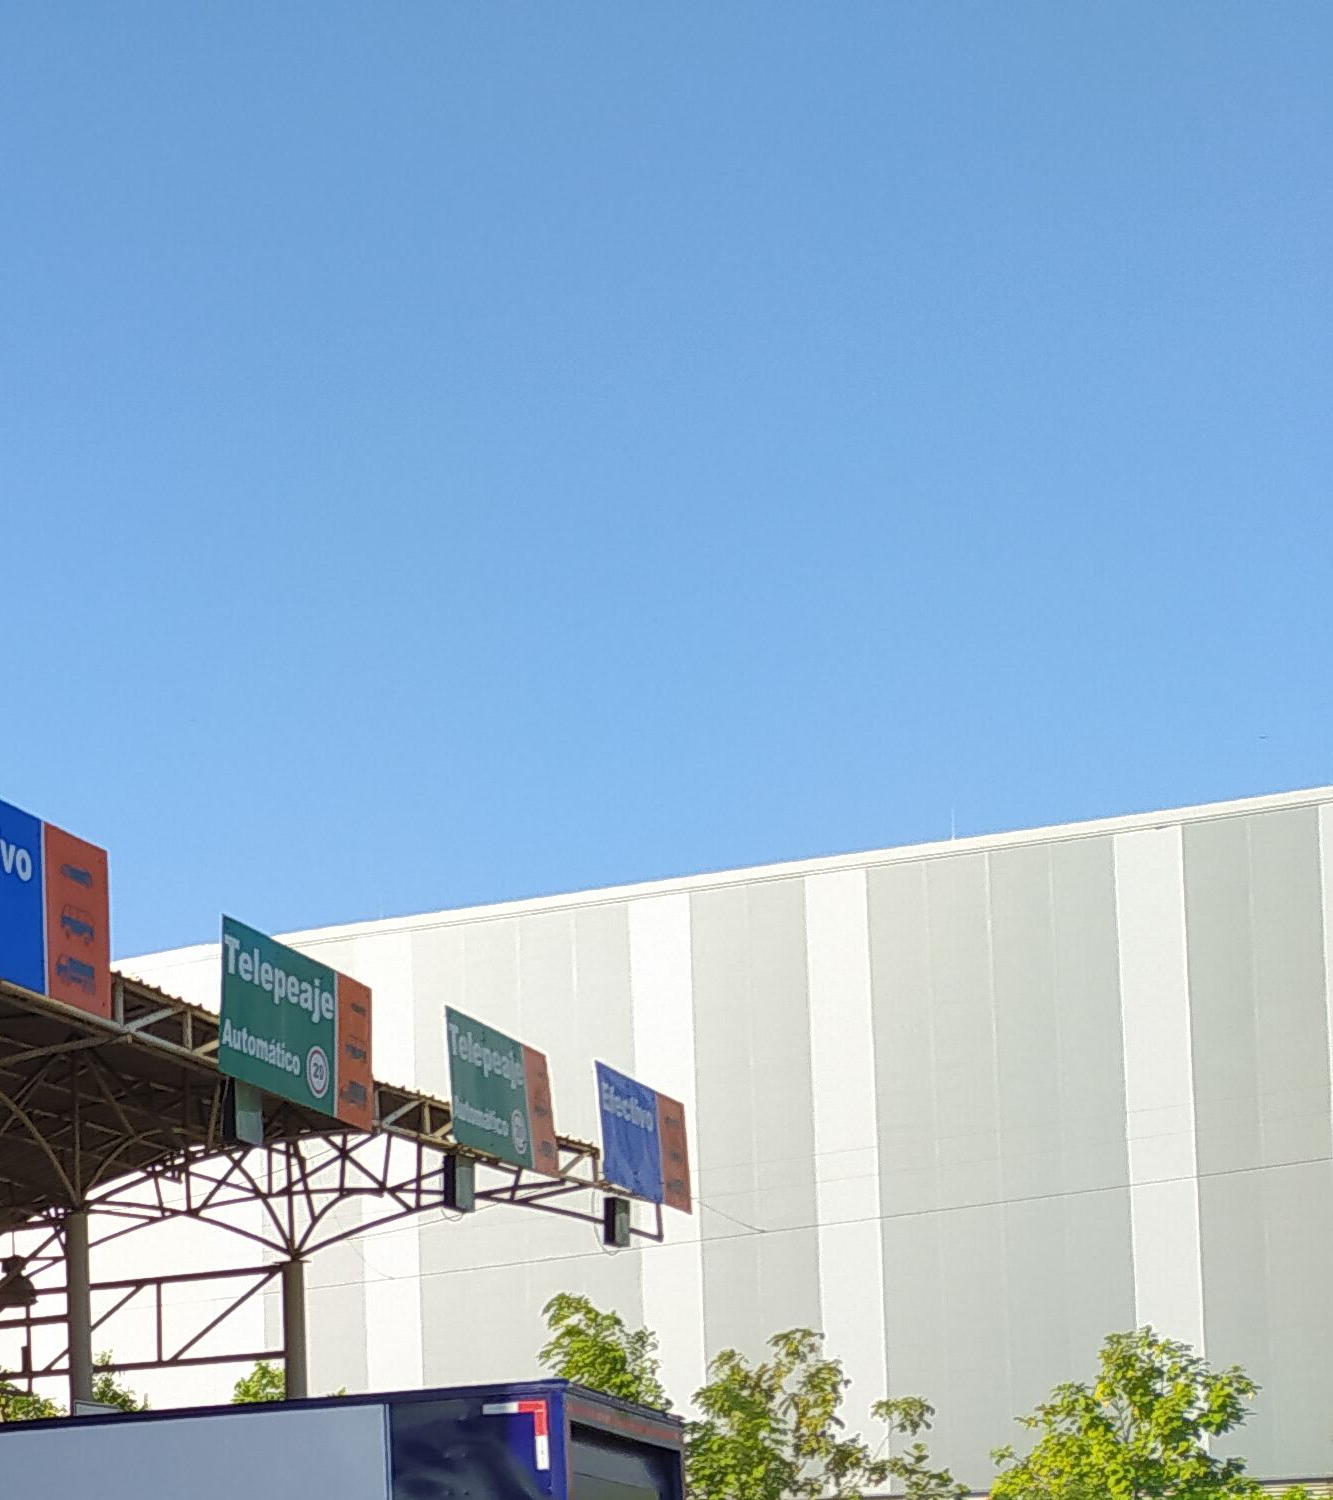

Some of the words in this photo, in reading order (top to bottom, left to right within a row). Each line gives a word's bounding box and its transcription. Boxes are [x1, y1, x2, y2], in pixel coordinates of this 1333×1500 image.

[224, 933, 334, 1024] Telepeaje
[222, 1017, 301, 1076] Automático
[449, 1022, 524, 1090] Telepeaje
